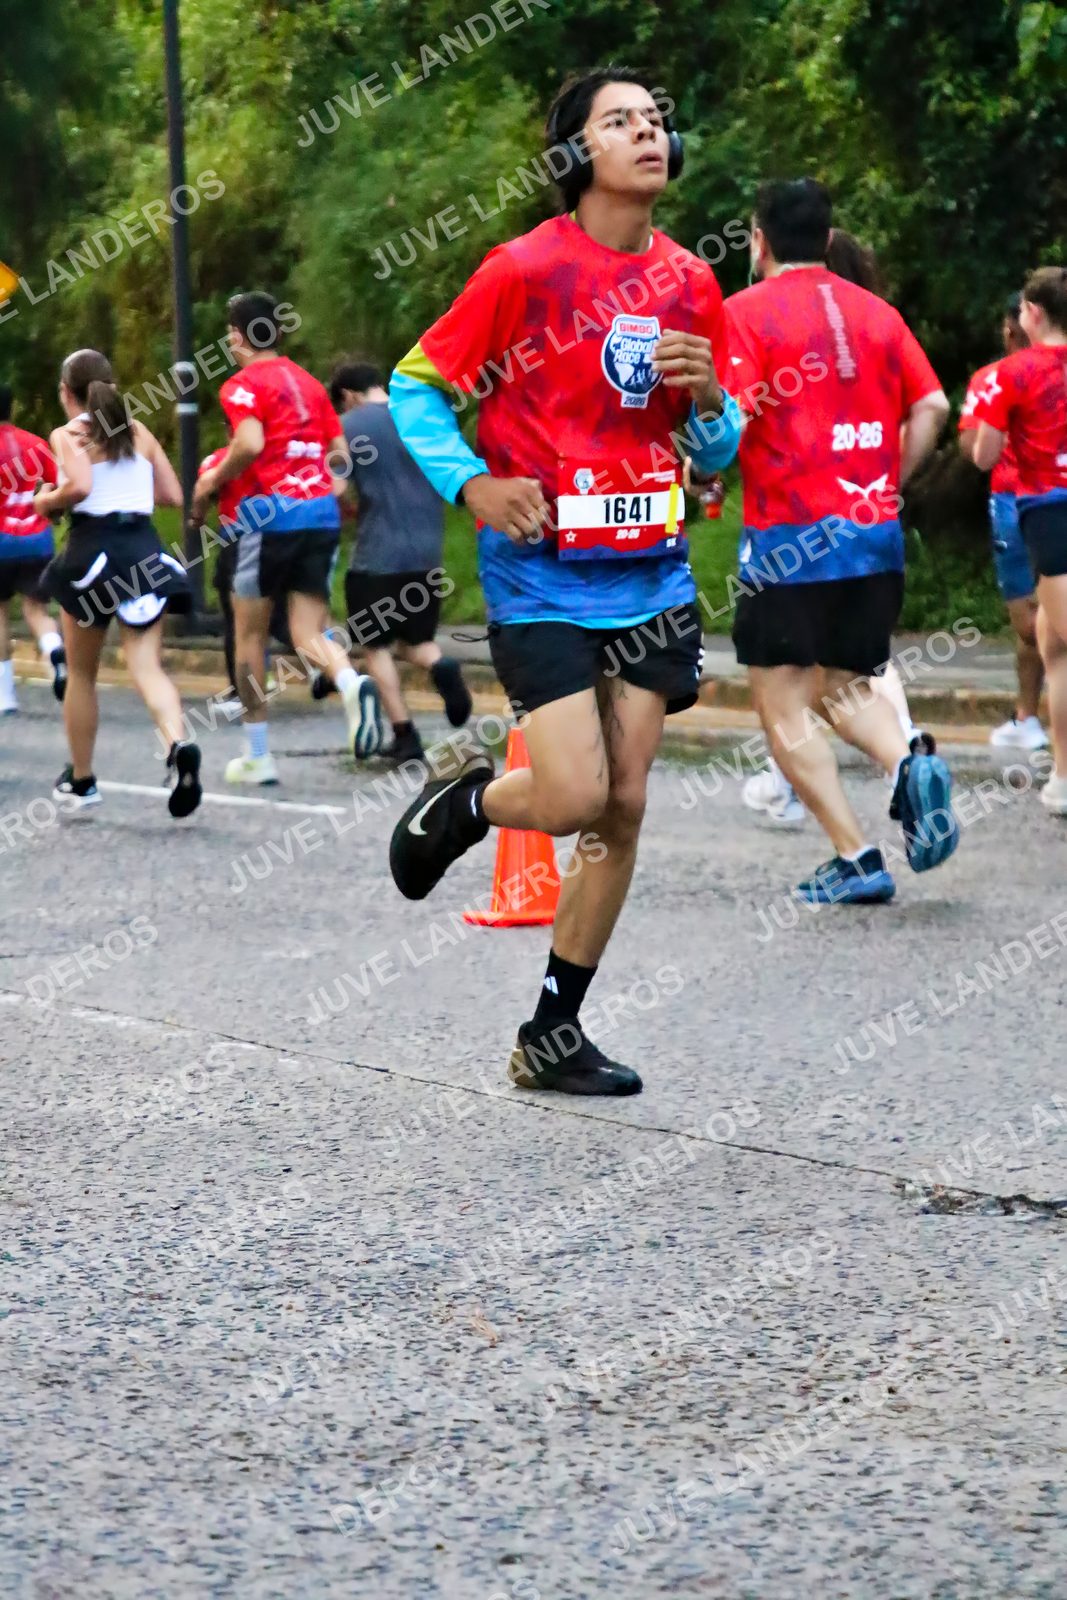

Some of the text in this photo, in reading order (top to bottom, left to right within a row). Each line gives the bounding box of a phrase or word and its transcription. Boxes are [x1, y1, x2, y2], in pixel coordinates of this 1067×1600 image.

[619, 322, 653, 335] BIMBO
[614, 351, 641, 364] Race
[603, 495, 651, 524] 1641
